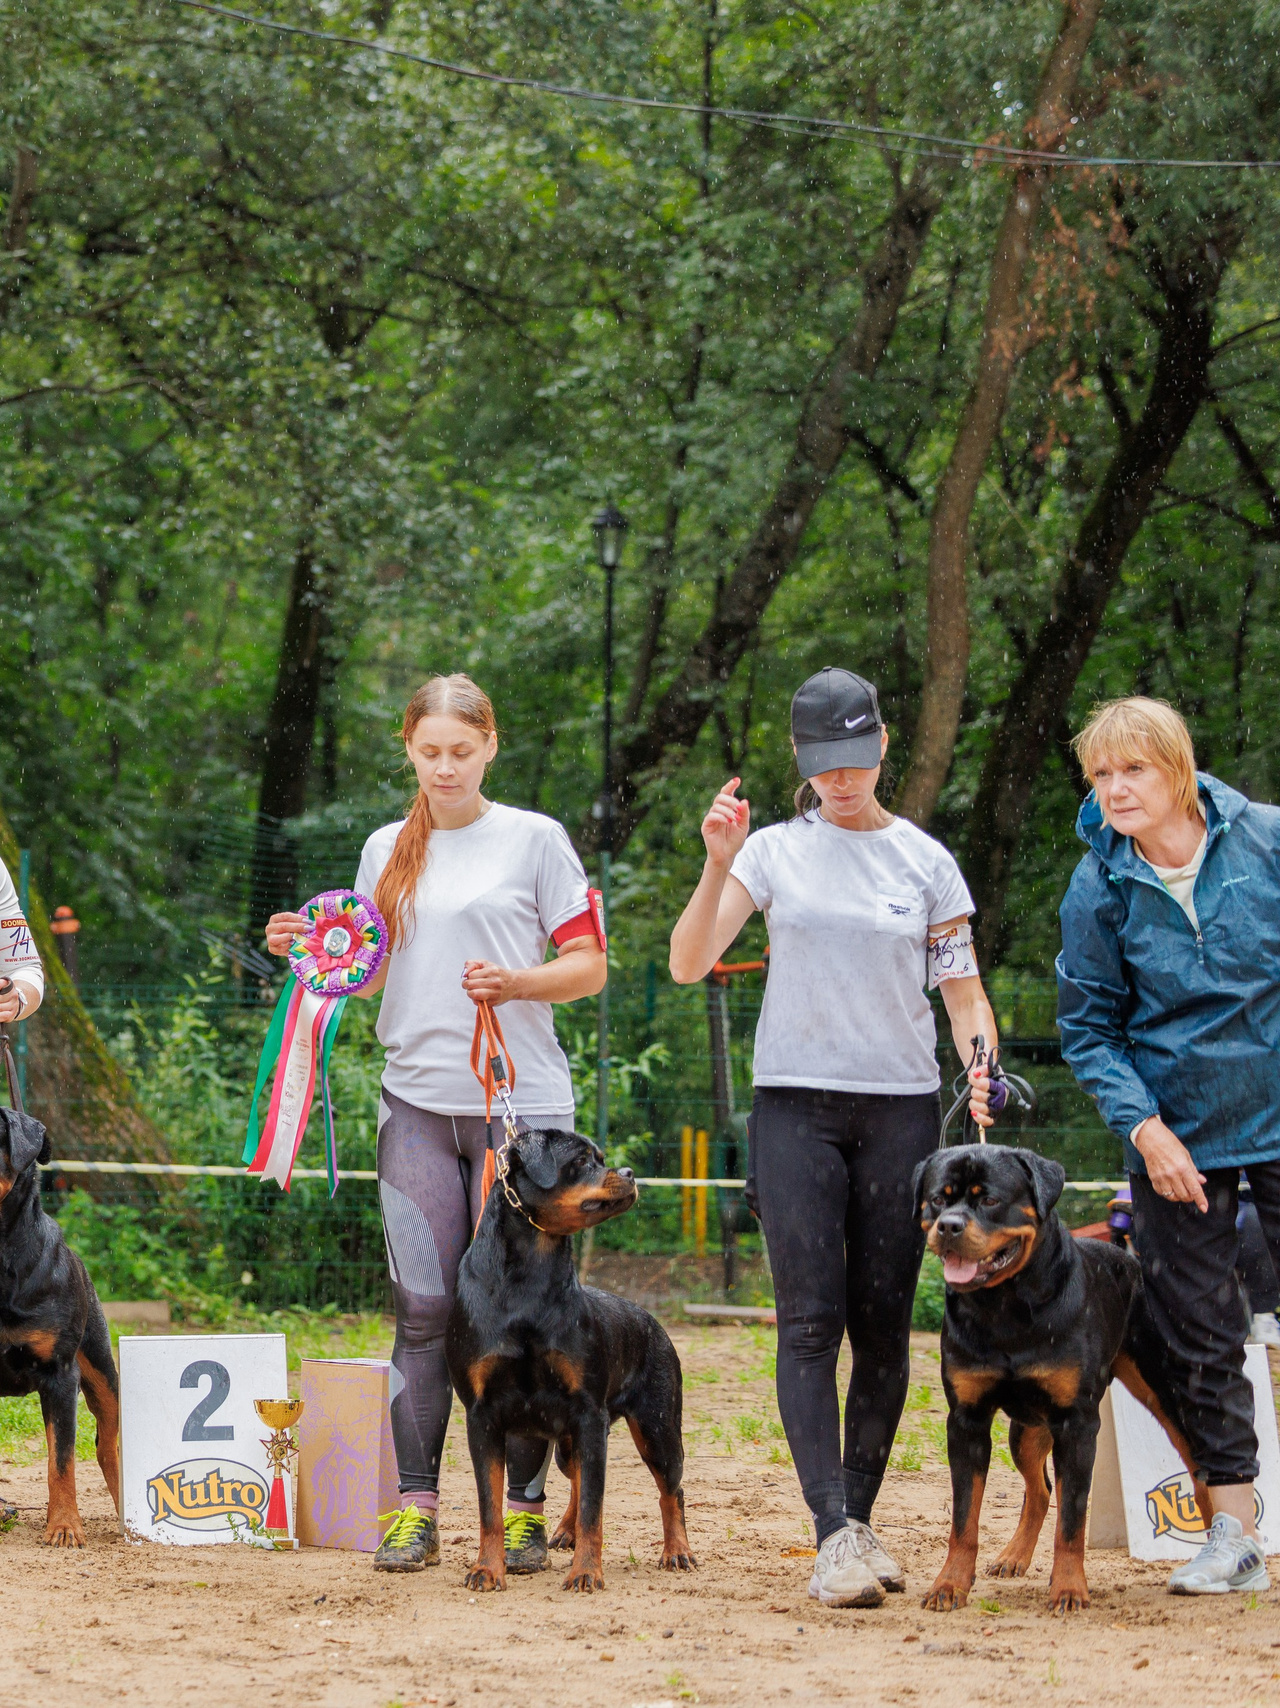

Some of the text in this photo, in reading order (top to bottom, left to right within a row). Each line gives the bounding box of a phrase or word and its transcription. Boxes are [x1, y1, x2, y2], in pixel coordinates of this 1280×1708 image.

[2, 919, 28, 927] ЗООМЕН
[10, 926, 29, 957] 14
[179, 1360, 235, 1442] 2
[147, 1467, 266, 1527] Nutro
